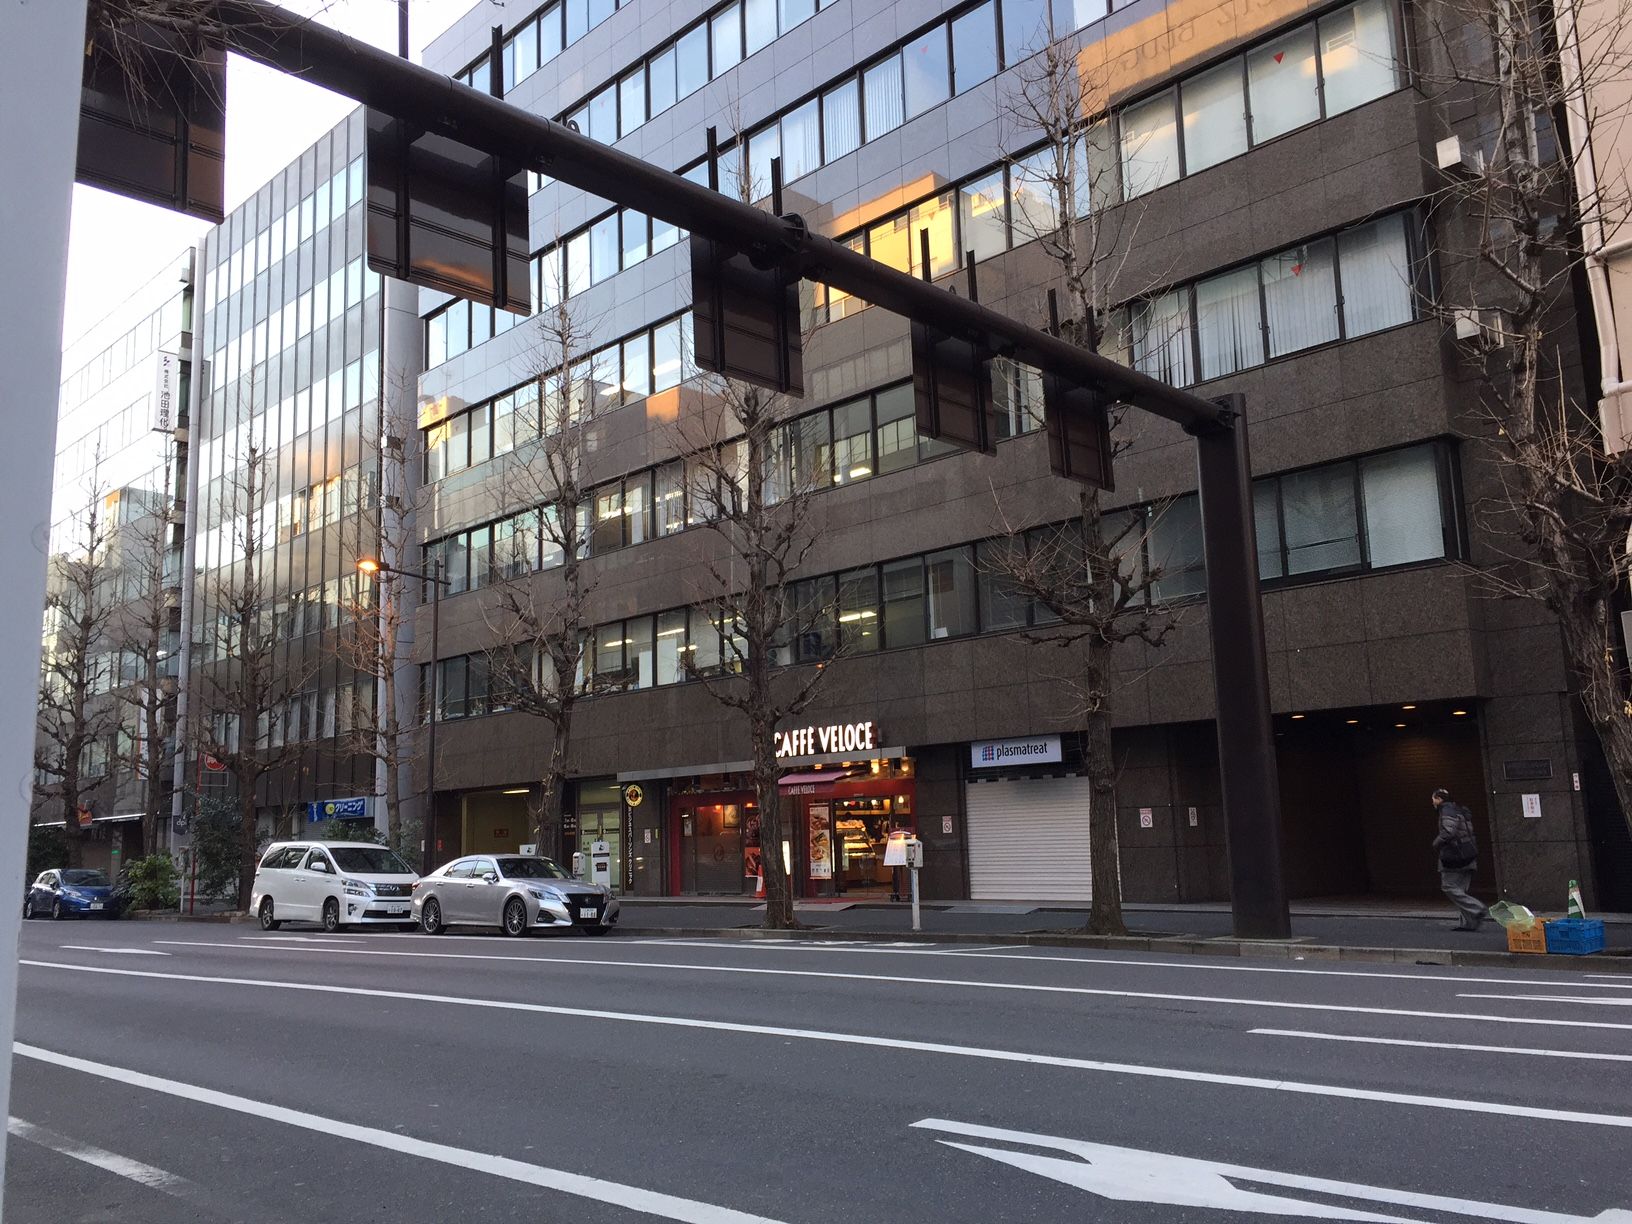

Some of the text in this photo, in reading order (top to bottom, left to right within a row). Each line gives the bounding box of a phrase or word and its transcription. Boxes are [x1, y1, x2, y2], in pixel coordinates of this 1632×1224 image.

[160, 391, 170, 430] 池田理化
[818, 721, 873, 753] VELOCE
[996, 742, 1048, 760] plasmatreat
[801, 784, 816, 795] VELOCE
[335, 800, 364, 812] クリーニング
